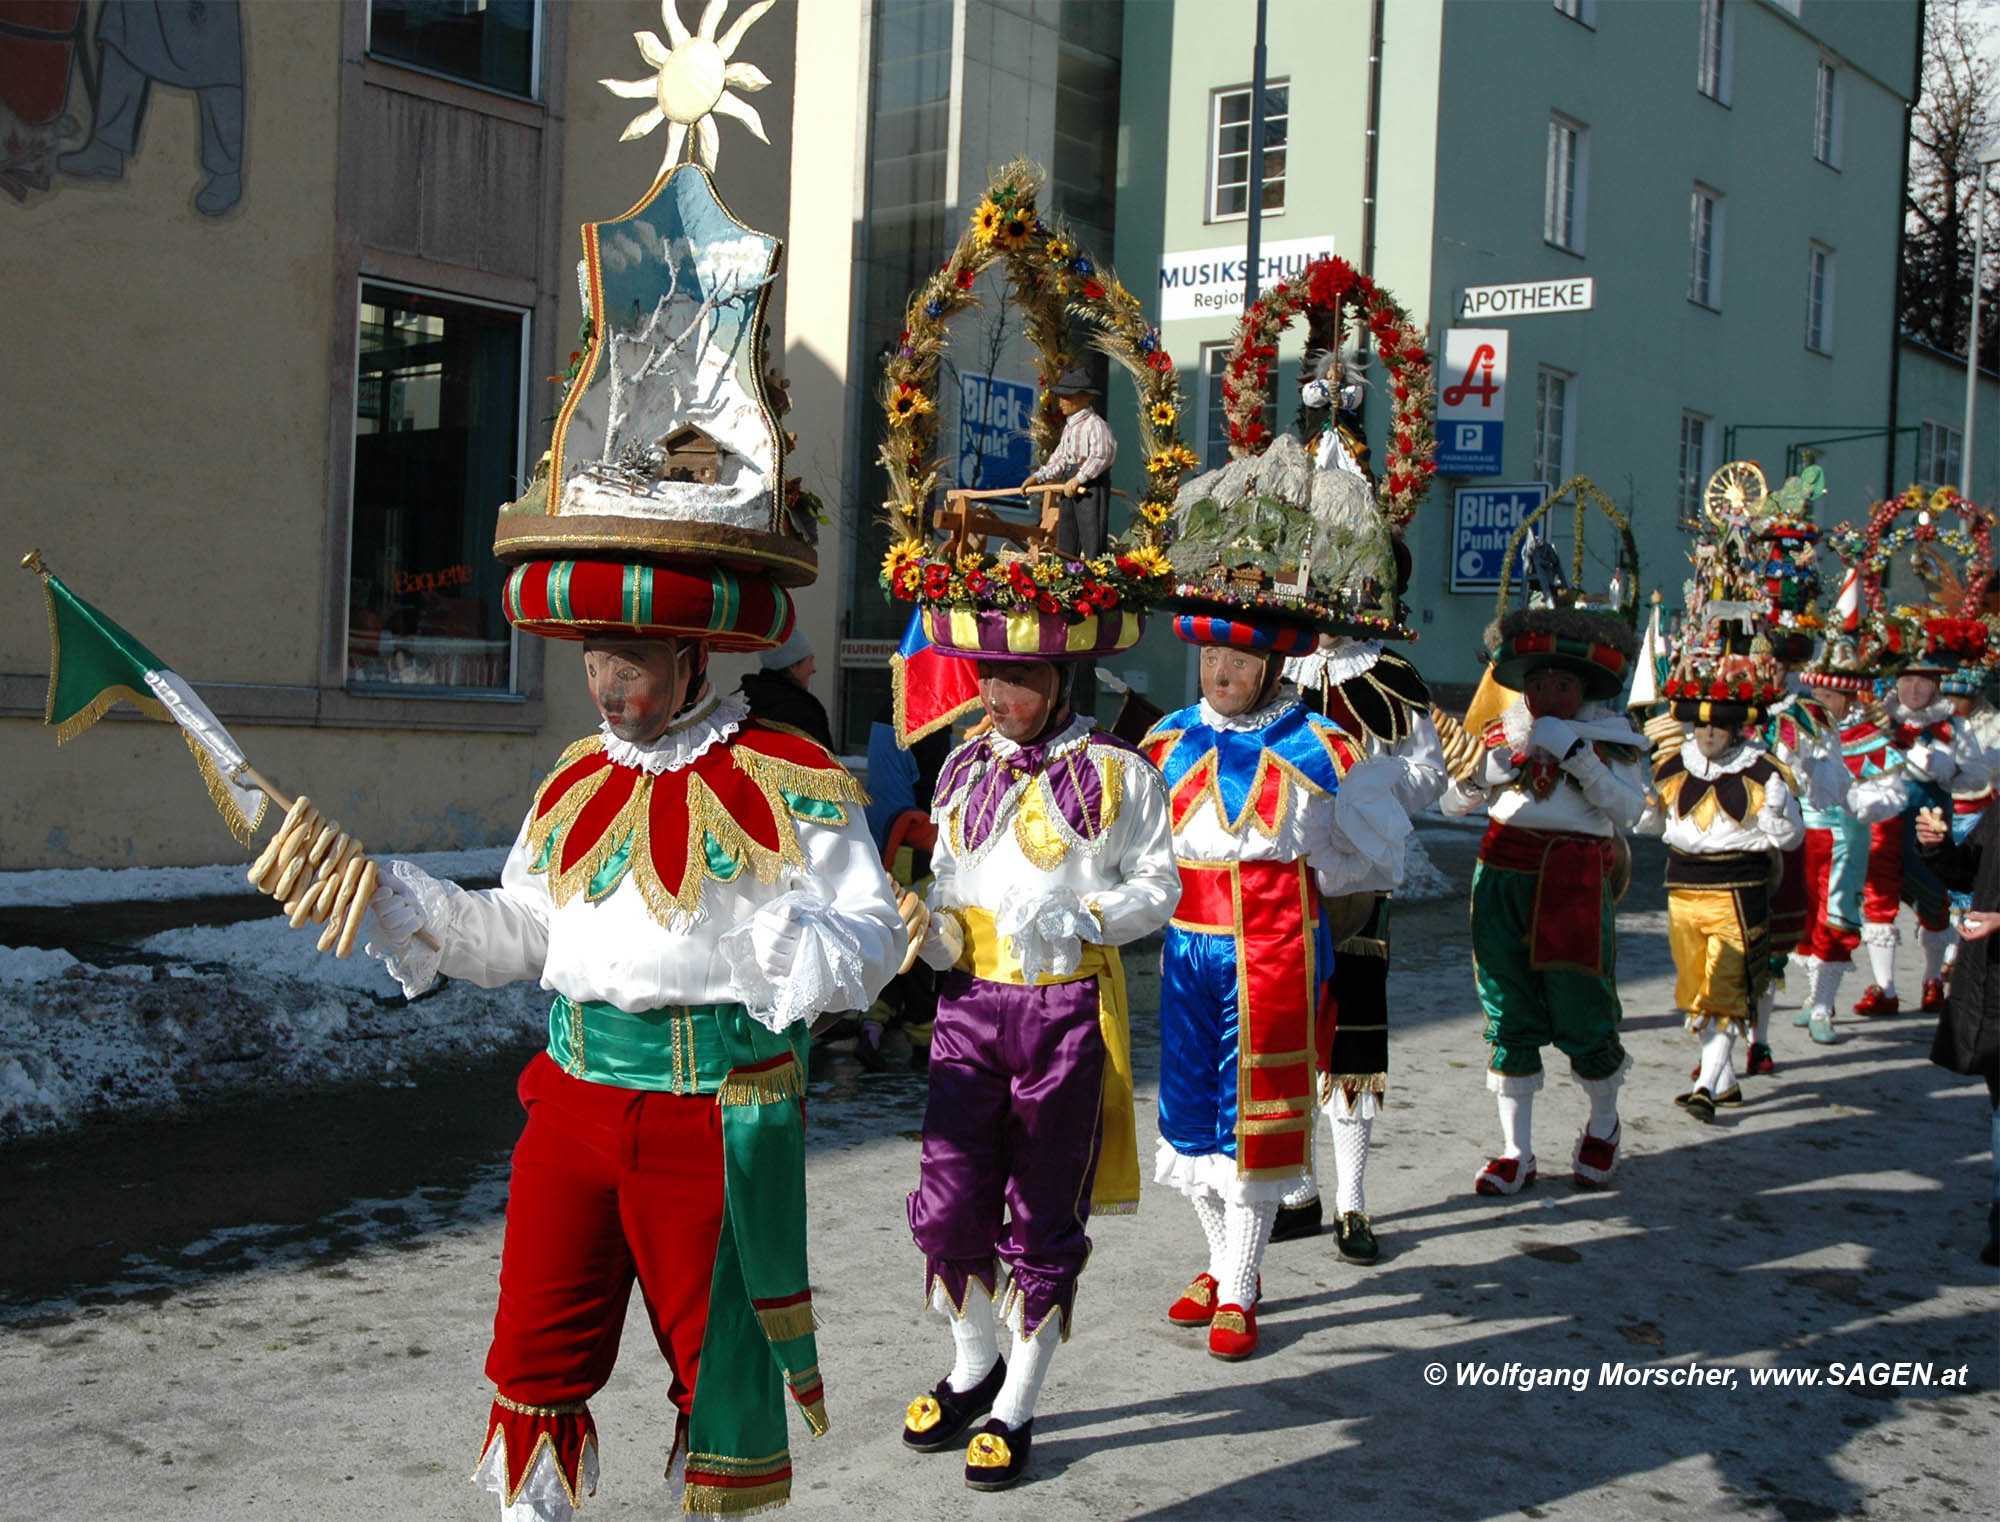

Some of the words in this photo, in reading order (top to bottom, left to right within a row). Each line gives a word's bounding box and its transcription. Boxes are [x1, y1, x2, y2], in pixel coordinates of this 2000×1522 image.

[1159, 250, 1331, 288] MUSIKSCHU
[1460, 283, 1584, 314] APOTHEKE
[963, 378, 1021, 432] Blick
[1462, 428, 1477, 447] P
[1461, 494, 1527, 528] Blick
[1460, 529, 1512, 551] Punkt
[394, 564, 472, 594] Baguette
